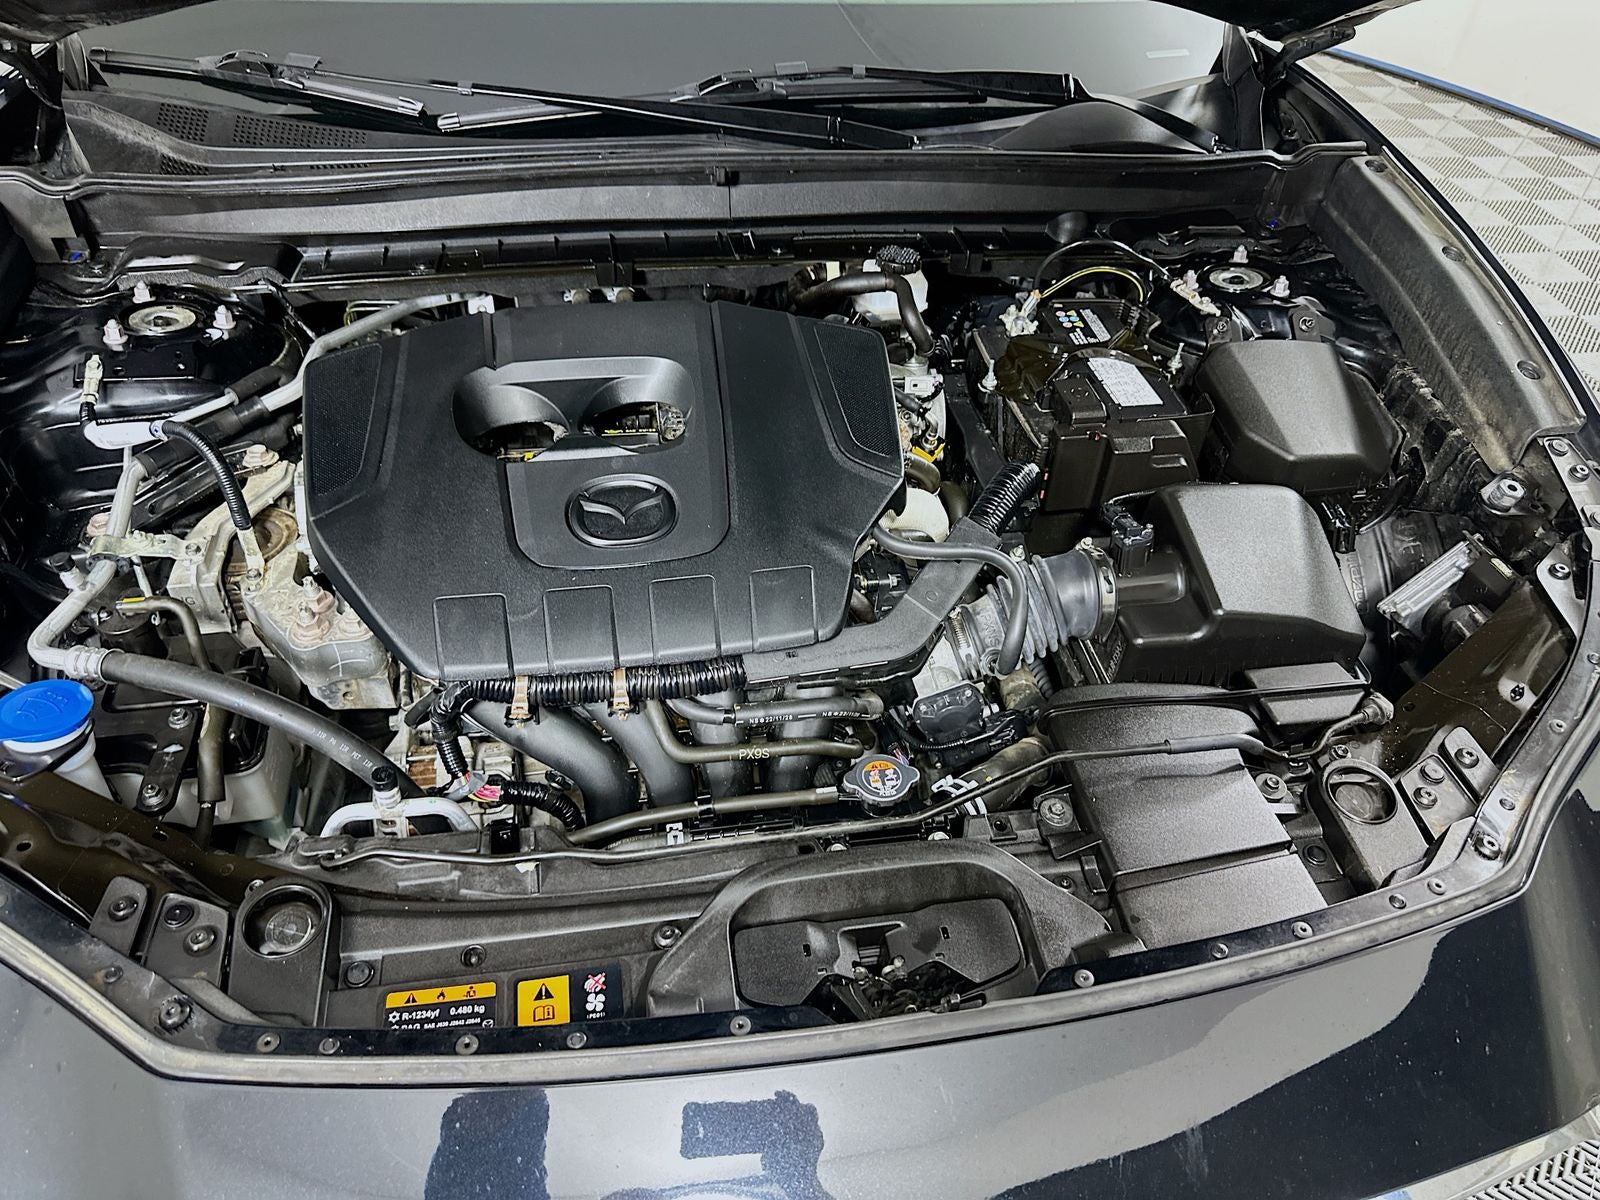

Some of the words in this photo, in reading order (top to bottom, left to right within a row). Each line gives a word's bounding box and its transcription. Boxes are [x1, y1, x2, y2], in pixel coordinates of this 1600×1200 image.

[739, 747, 770, 760] PX9S
[401, 1008, 440, 1021] R-1234yf
[449, 1005, 473, 1016] 0.480
[473, 1004, 485, 1014] kg
